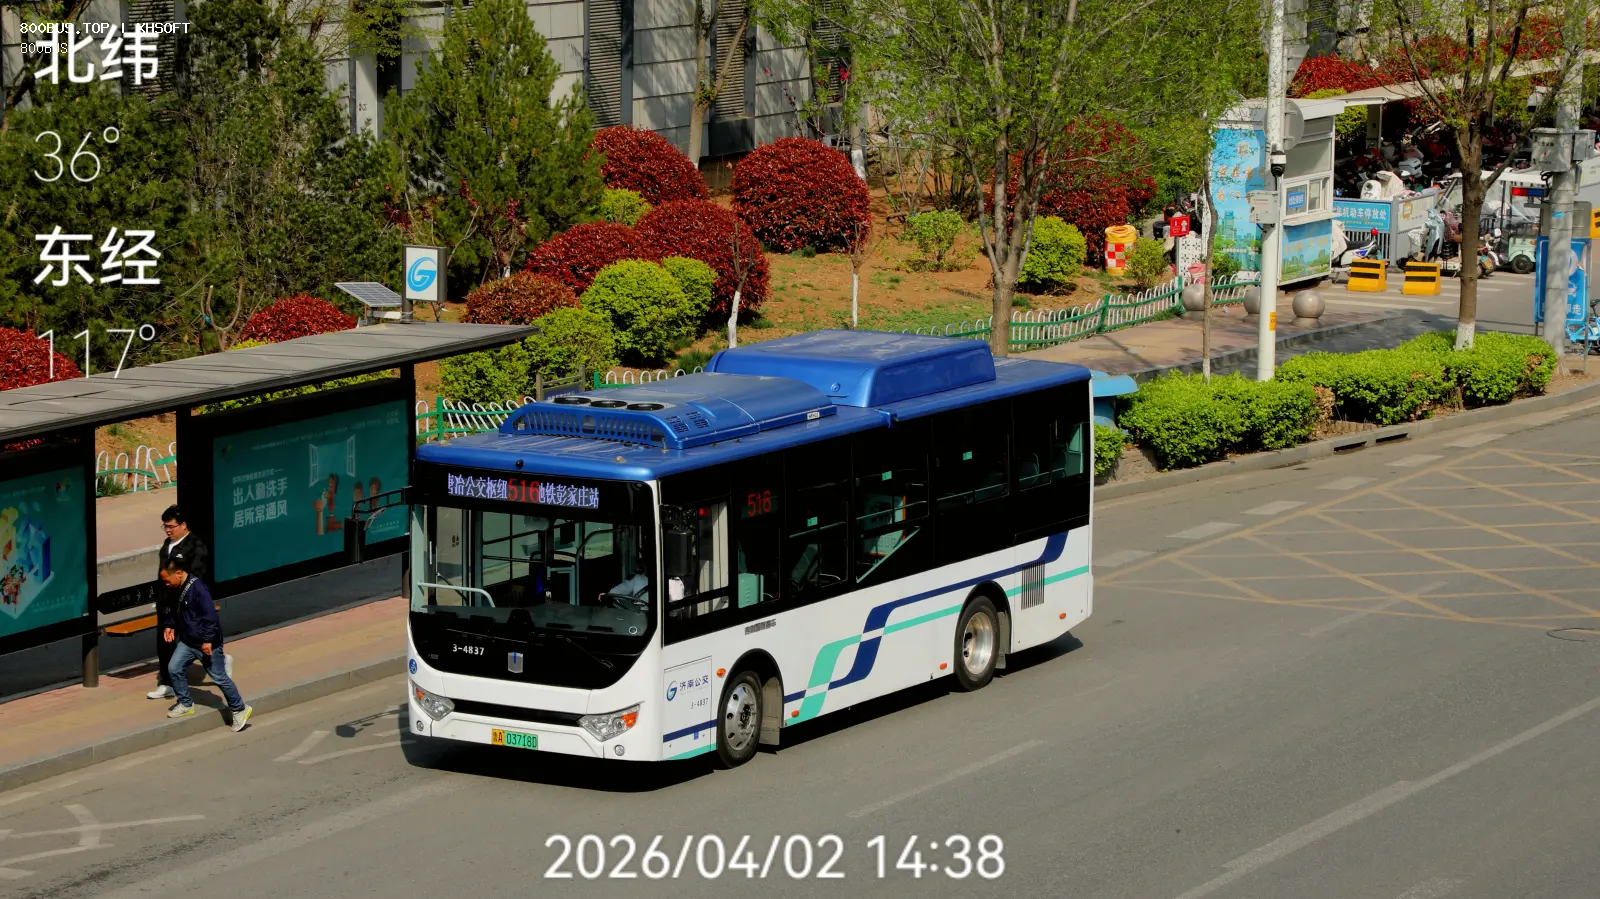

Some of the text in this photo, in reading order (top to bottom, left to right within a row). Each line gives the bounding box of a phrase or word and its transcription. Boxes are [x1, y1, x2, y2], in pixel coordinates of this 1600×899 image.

[232, 476, 288, 506] 出人勤洗手
[507, 478, 540, 504] 516
[747, 489, 772, 517] 516
[232, 499, 288, 529] 居所常通风
[452, 643, 485, 656] 3-4837
[679, 674, 709, 692] 济南公交
